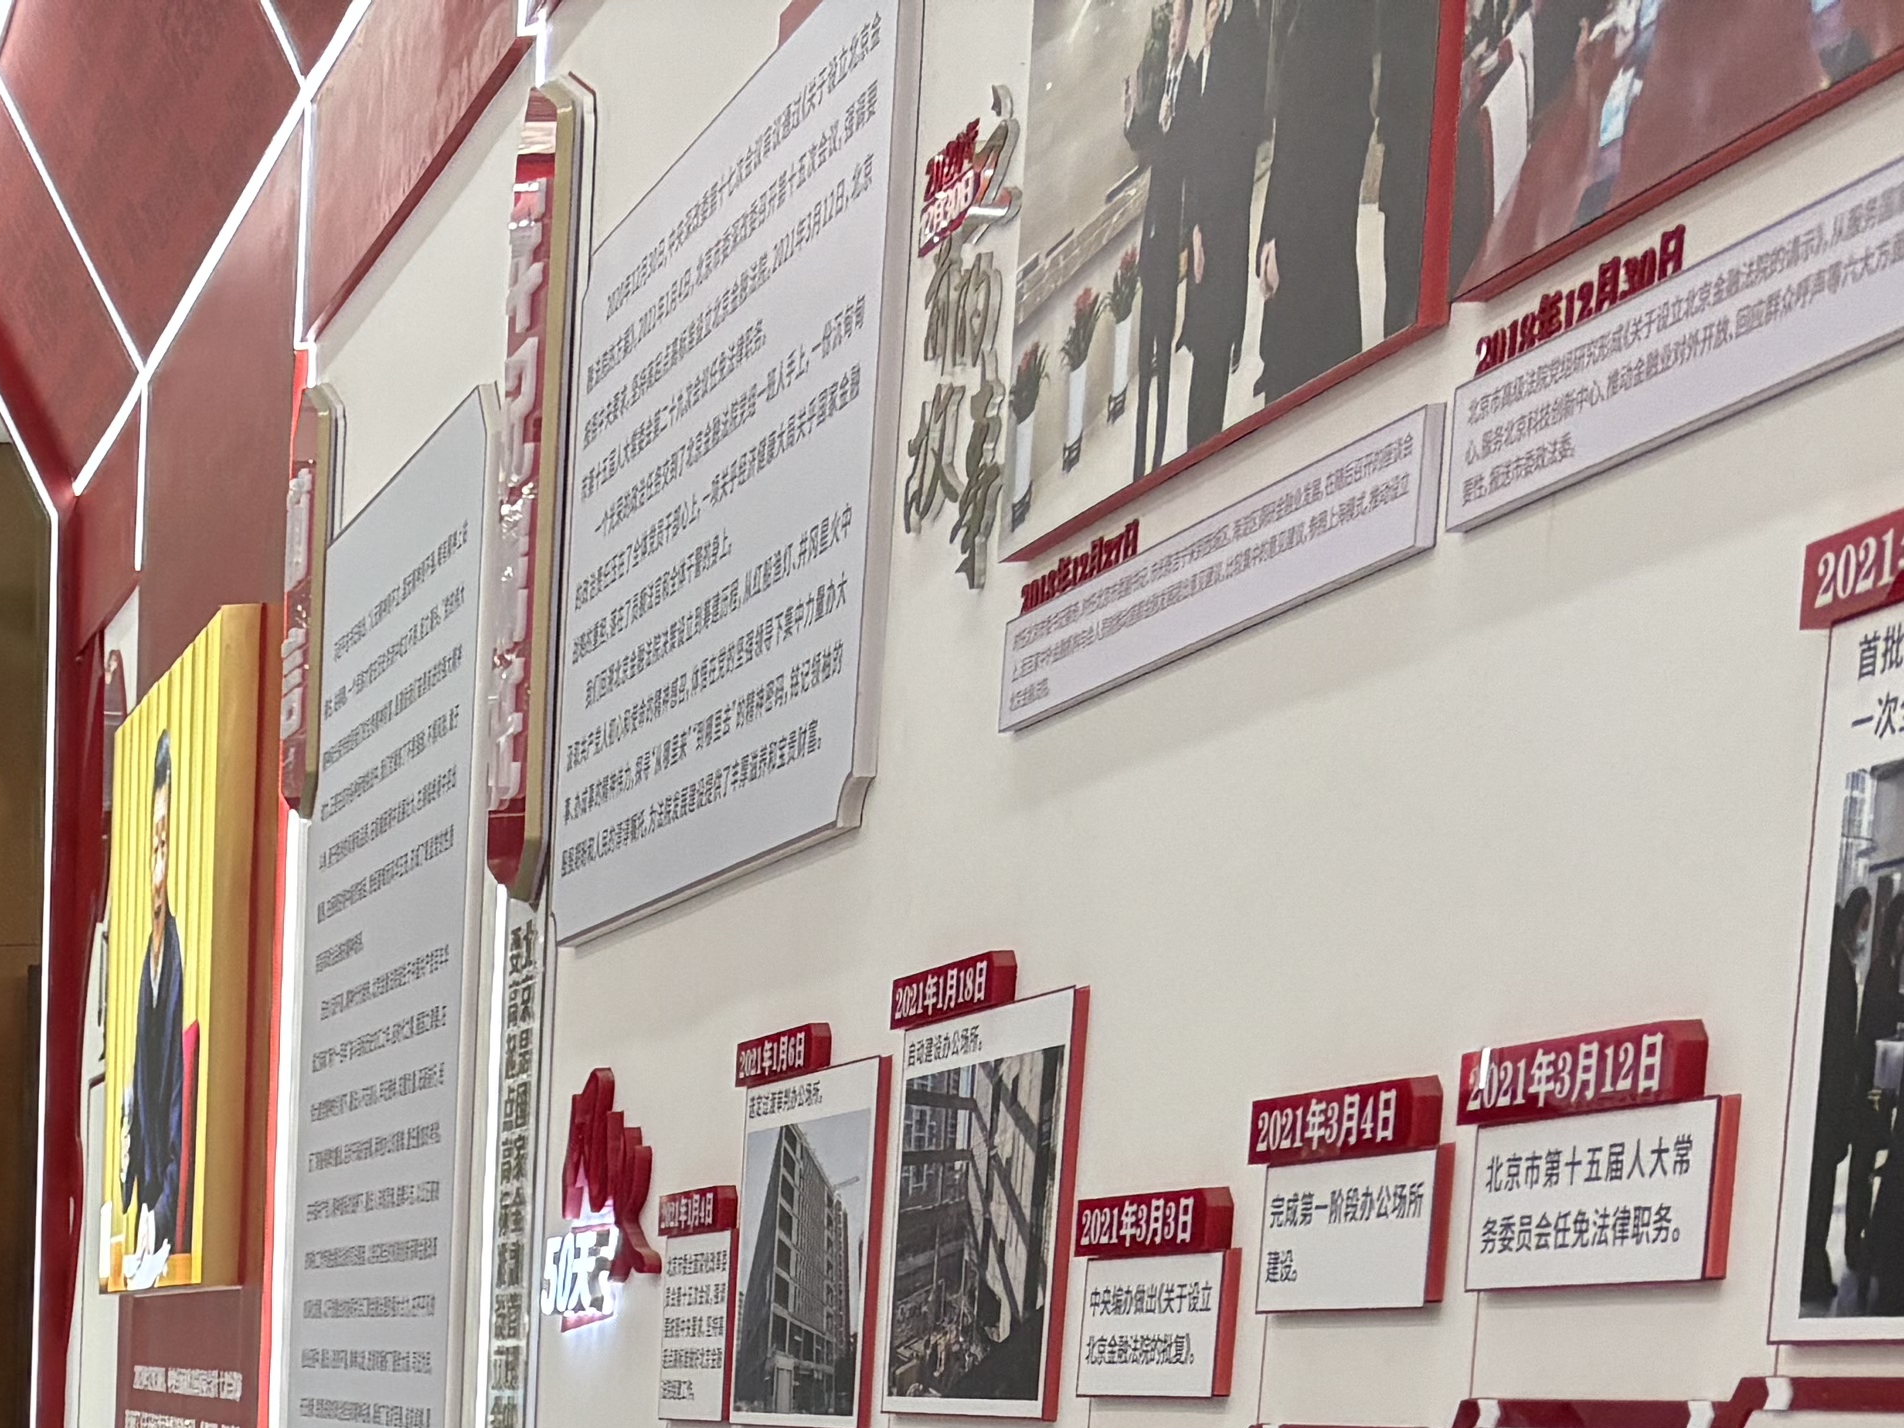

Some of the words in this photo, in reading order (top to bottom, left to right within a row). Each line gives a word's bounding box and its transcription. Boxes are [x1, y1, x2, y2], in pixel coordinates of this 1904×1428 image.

[1813, 525, 1904, 610] 2021
[1850, 690, 1904, 740] 一次
[894, 960, 988, 1021] 2021年1月18日
[738, 1037, 806, 1081] 2021年1月6日
[1466, 1032, 1666, 1112] 2021年3月12日
[1256, 1089, 1397, 1153] 2021年3月4日
[1486, 1133, 1693, 1193] 北京市第十五届人大常
[1080, 1202, 1193, 1247] 2021年3月3日
[1270, 1180, 1425, 1229] 完成第一阶段办公场所
[1480, 1203, 1681, 1257] 务委员会任免法律职务。
